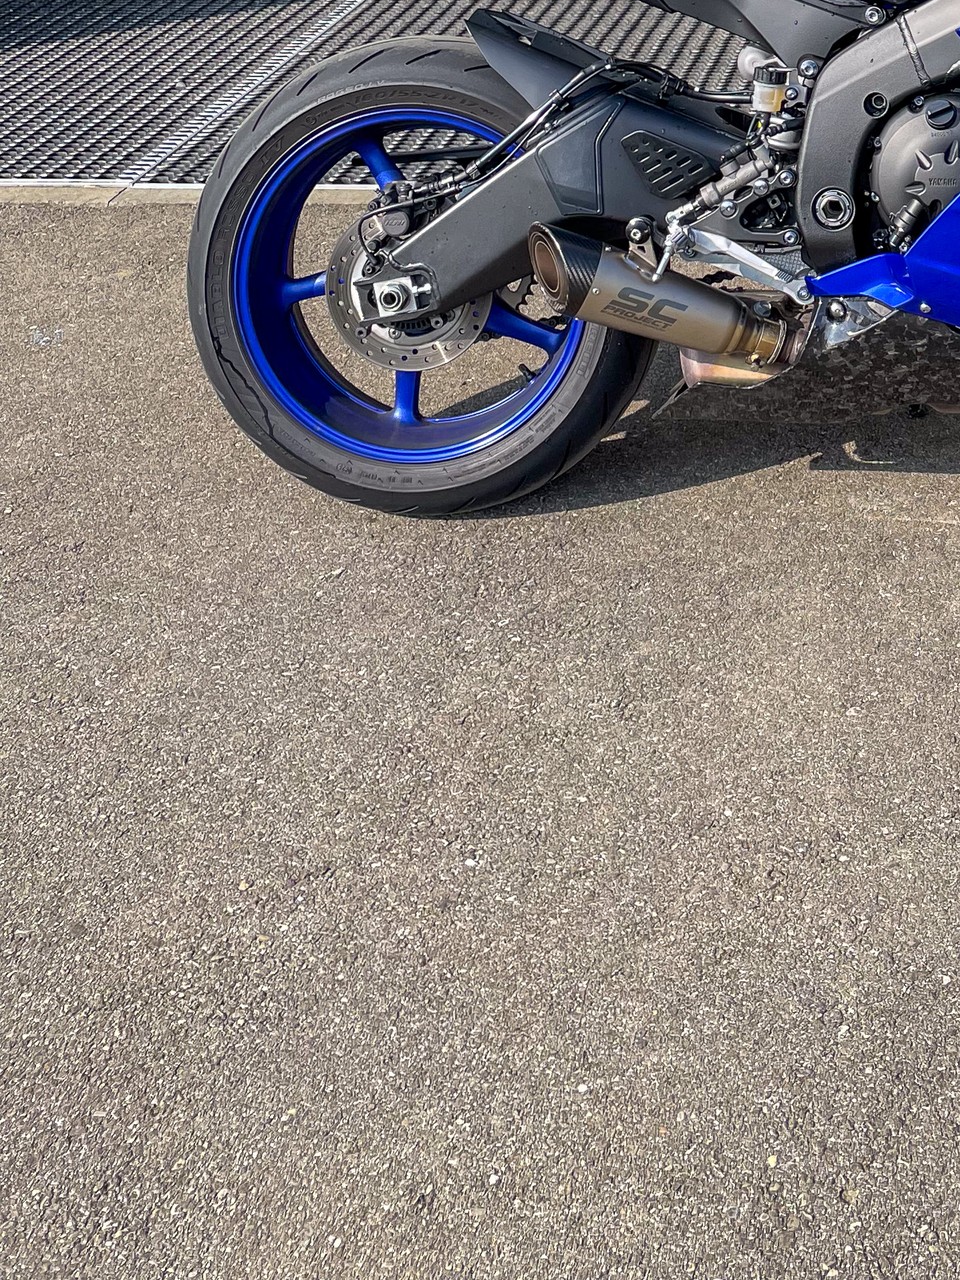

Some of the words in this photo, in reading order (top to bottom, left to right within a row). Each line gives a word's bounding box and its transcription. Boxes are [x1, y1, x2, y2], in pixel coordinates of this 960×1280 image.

[928, 177, 959, 188] YAMAHA
[209, 249, 231, 340] DIABLO
[616, 285, 690, 325] SC
[602, 304, 674, 329] PROJECT
[575, 322, 600, 377] IRELLI
